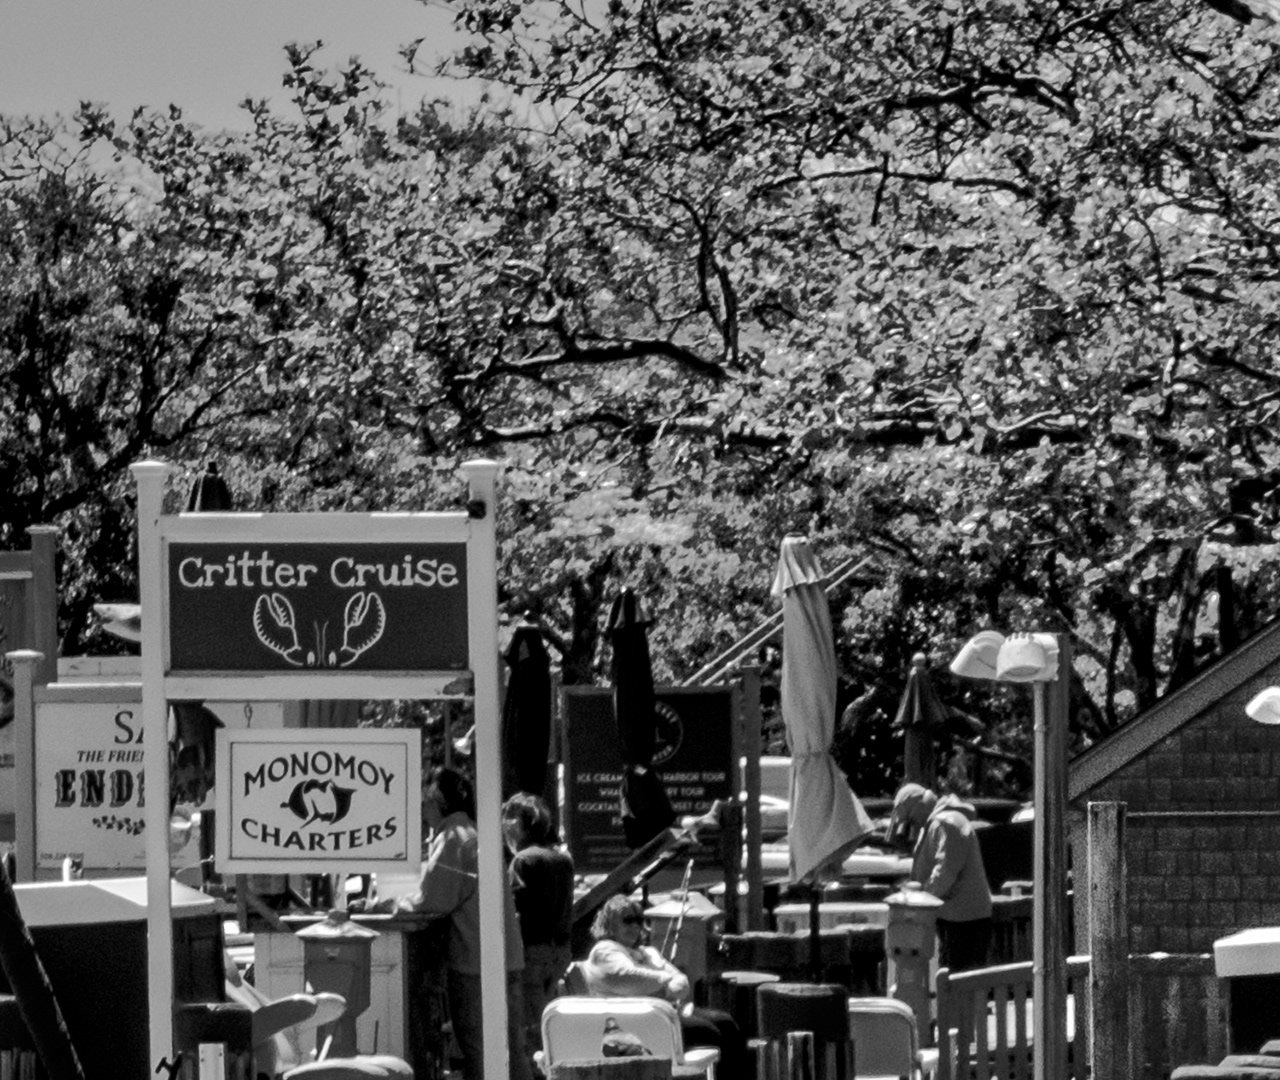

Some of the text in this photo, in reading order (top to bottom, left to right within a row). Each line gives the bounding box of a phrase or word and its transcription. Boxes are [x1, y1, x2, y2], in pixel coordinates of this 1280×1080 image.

[179, 550, 459, 588] Critter Cruise
[77, 750, 104, 763] THE
[244, 750, 395, 797] MONOMOY
[241, 816, 397, 851] CHARTERS
